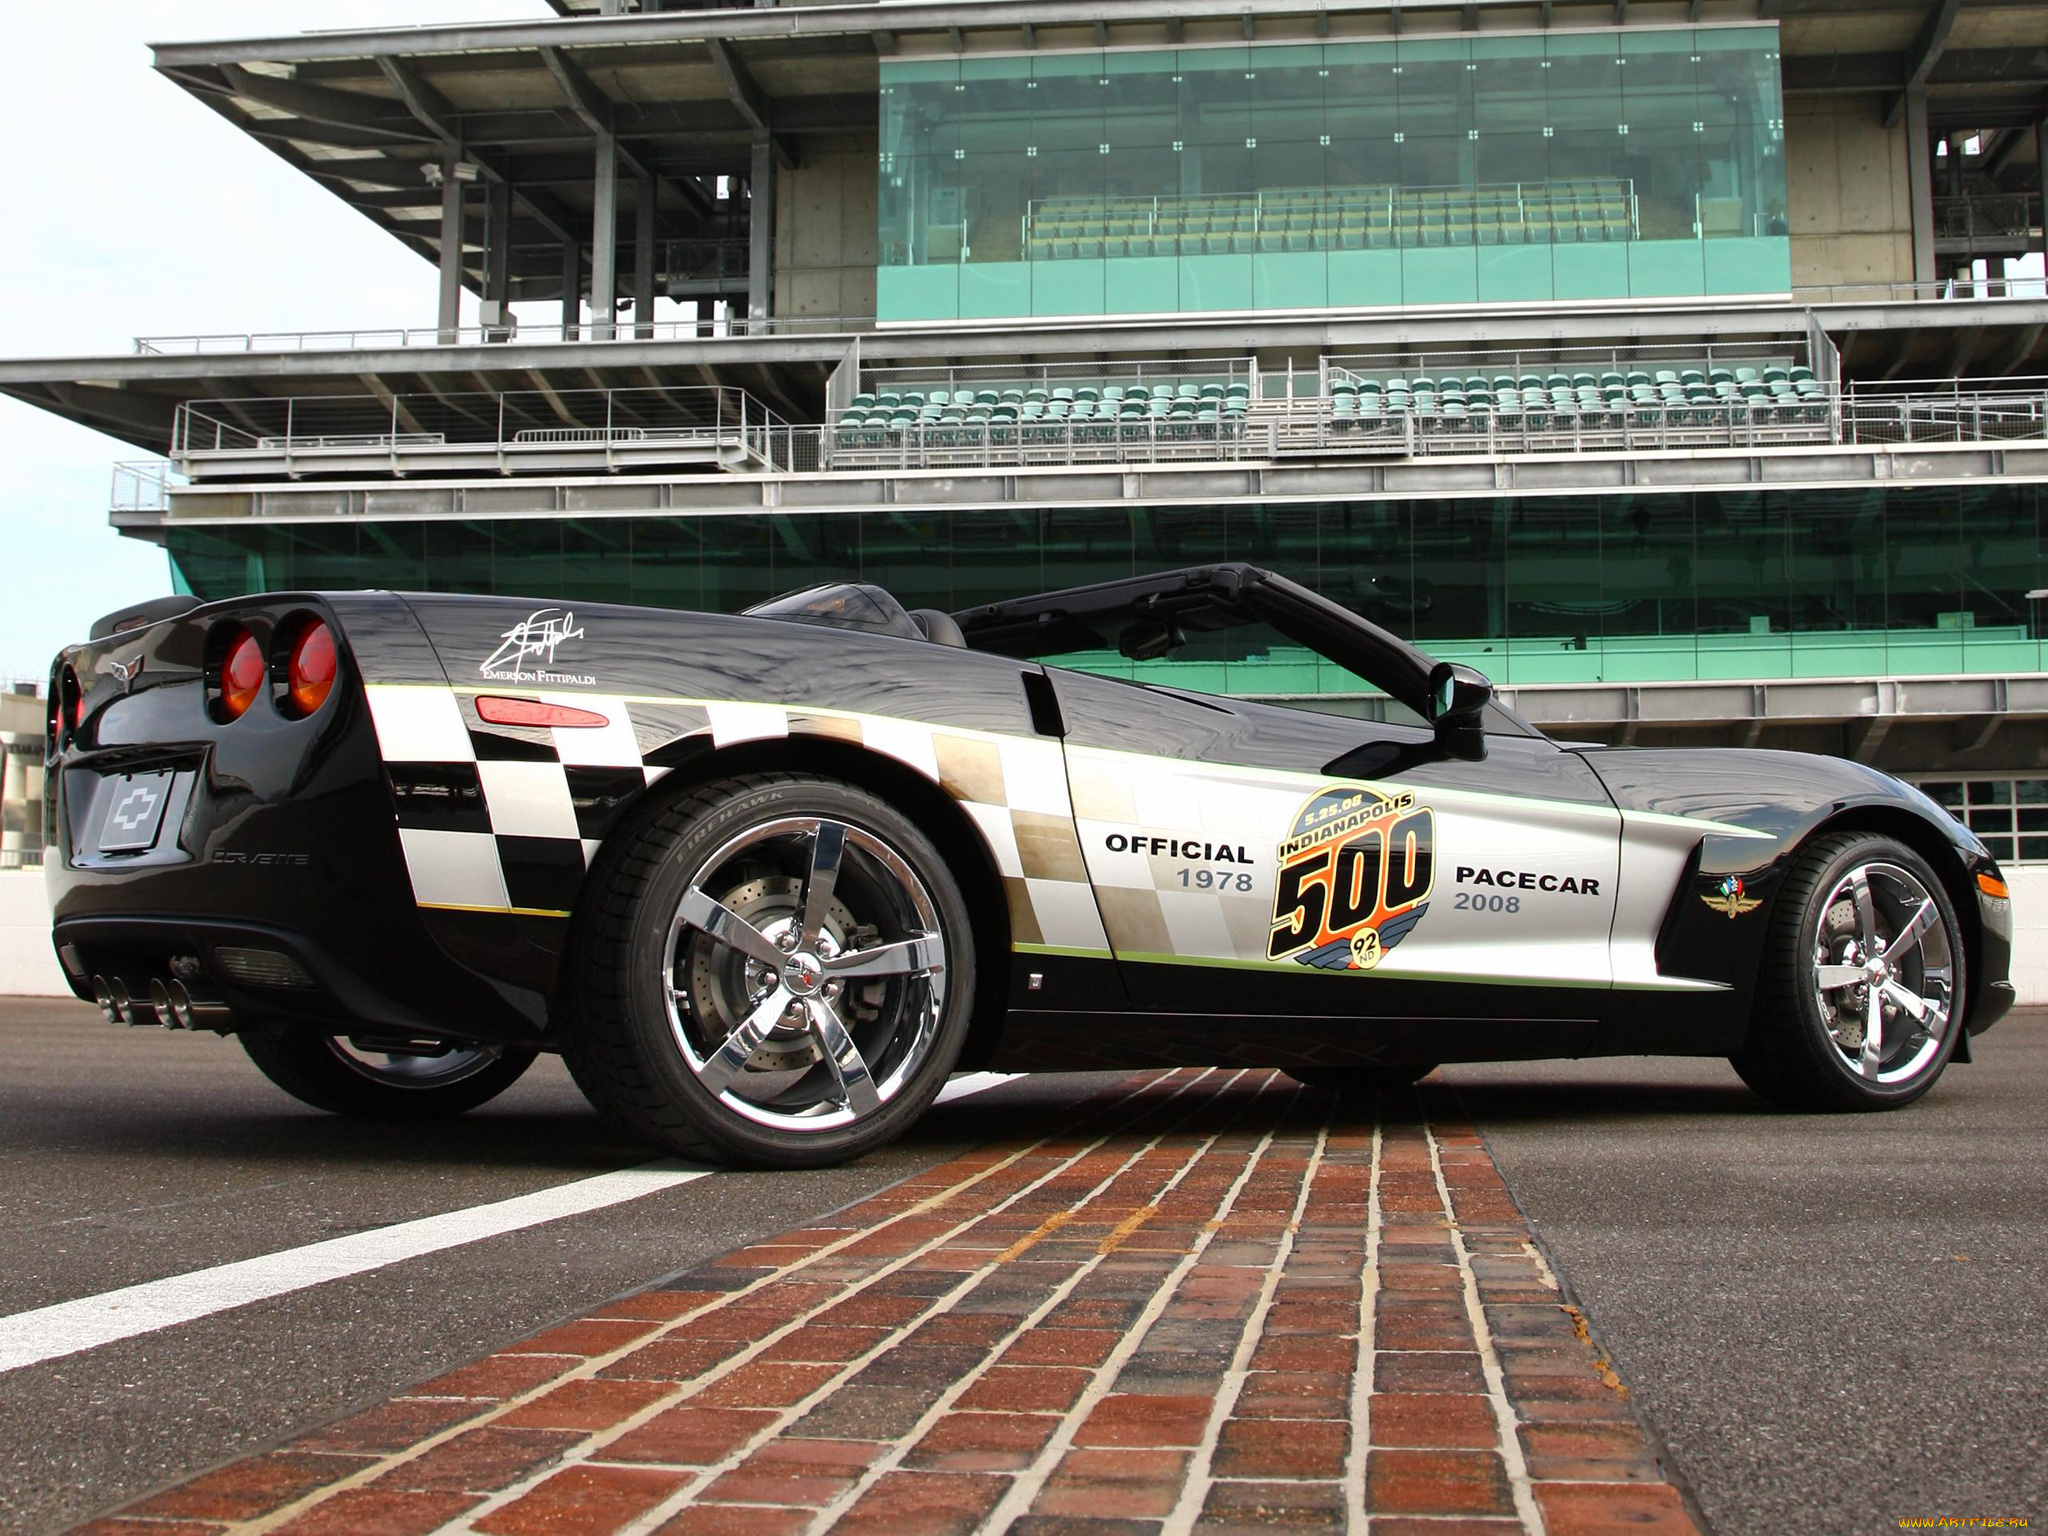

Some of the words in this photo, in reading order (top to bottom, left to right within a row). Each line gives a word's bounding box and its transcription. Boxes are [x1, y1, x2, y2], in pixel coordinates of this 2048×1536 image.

[483, 669, 535, 681] EMERSON
[536, 669, 597, 686] FITTIPALDI
[1304, 794, 1363, 826] 5.25.08
[676, 791, 783, 864] FIREHAWK
[1279, 794, 1412, 858] INDIANAPOLIS
[213, 851, 309, 865] CORVETTE
[1105, 833, 1254, 864] OFFICIAL
[1176, 868, 1253, 892] 1978
[1268, 809, 1433, 958] 500
[1456, 866, 1600, 896] PACECAR
[1453, 892, 1520, 914] 2008
[1353, 932, 1377, 955] 92
